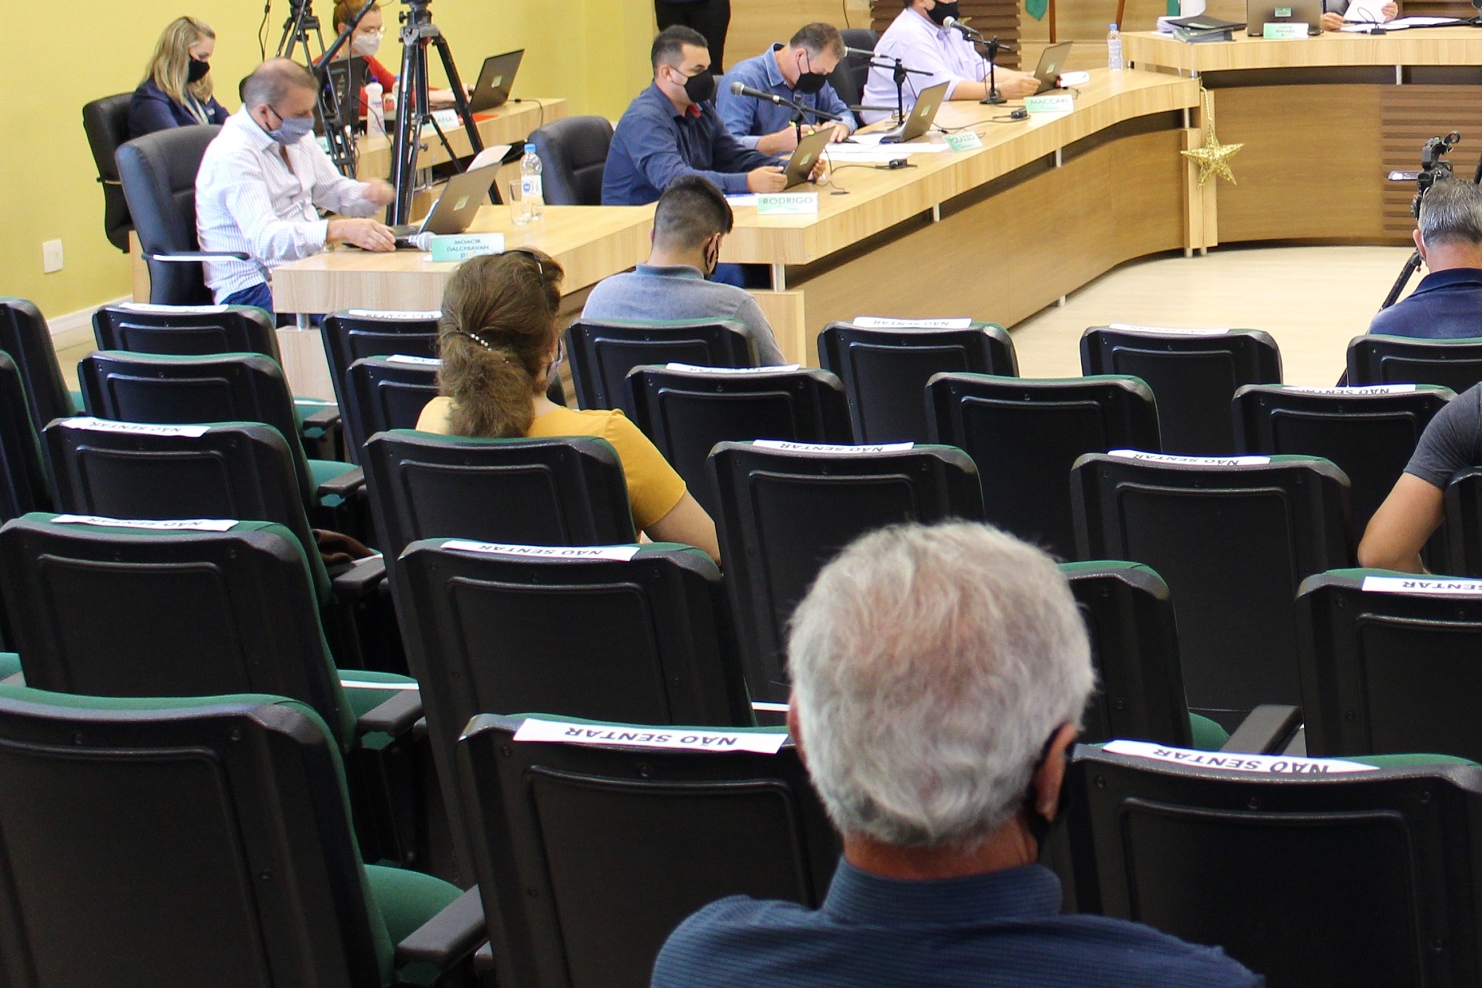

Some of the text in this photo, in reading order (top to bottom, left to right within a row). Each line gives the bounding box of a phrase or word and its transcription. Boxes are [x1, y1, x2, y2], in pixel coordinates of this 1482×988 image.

[763, 196, 813, 204] RODRIGO
[89, 421, 148, 430] SENTAR
[780, 443, 844, 451] SENTAR
[1132, 454, 1200, 462] SENTAR
[86, 518, 160, 526] SENTAR
[478, 545, 604, 557] NÃO SENTAR
[564, 726, 738, 747] NÃO SENTAR
[1153, 748, 1264, 770] SENTAR
